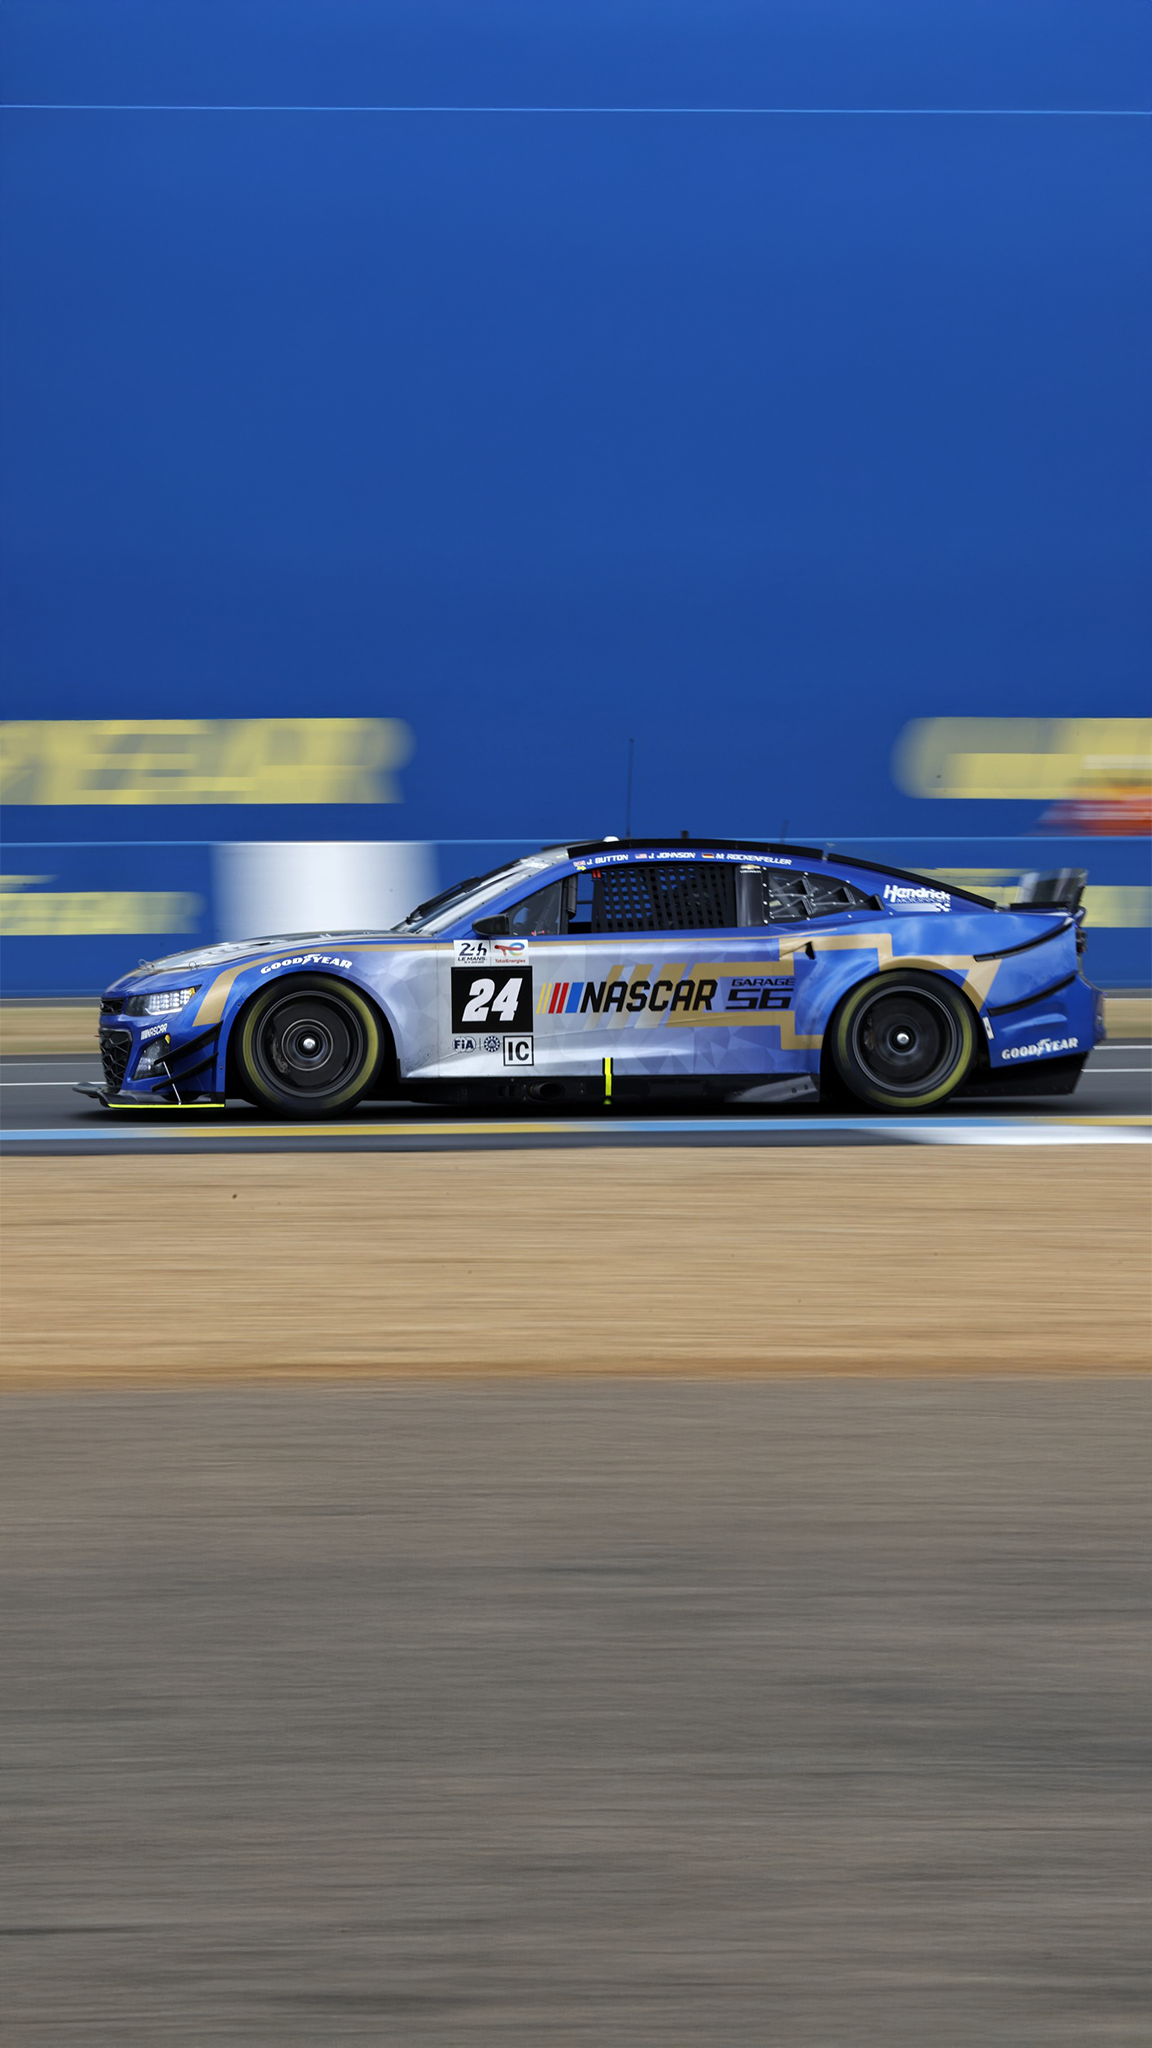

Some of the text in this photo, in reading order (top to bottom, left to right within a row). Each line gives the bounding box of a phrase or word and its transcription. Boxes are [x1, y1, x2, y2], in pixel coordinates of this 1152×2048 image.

[595, 854, 629, 864] BUTTON
[656, 852, 696, 860] JOHNSON
[726, 854, 792, 865] ROCKENFELLER
[883, 884, 951, 903] Hendrick
[459, 942, 487, 957] 24h
[260, 953, 353, 974] GOODYEAR
[731, 977, 797, 987] GARAGE
[461, 978, 523, 1022] 24
[580, 979, 718, 1014] NASCAR
[725, 988, 795, 1010] 56
[147, 1023, 168, 1037] NASCAR
[508, 1041, 530, 1061] IC
[1001, 1037, 1079, 1060] GOODYEAR
